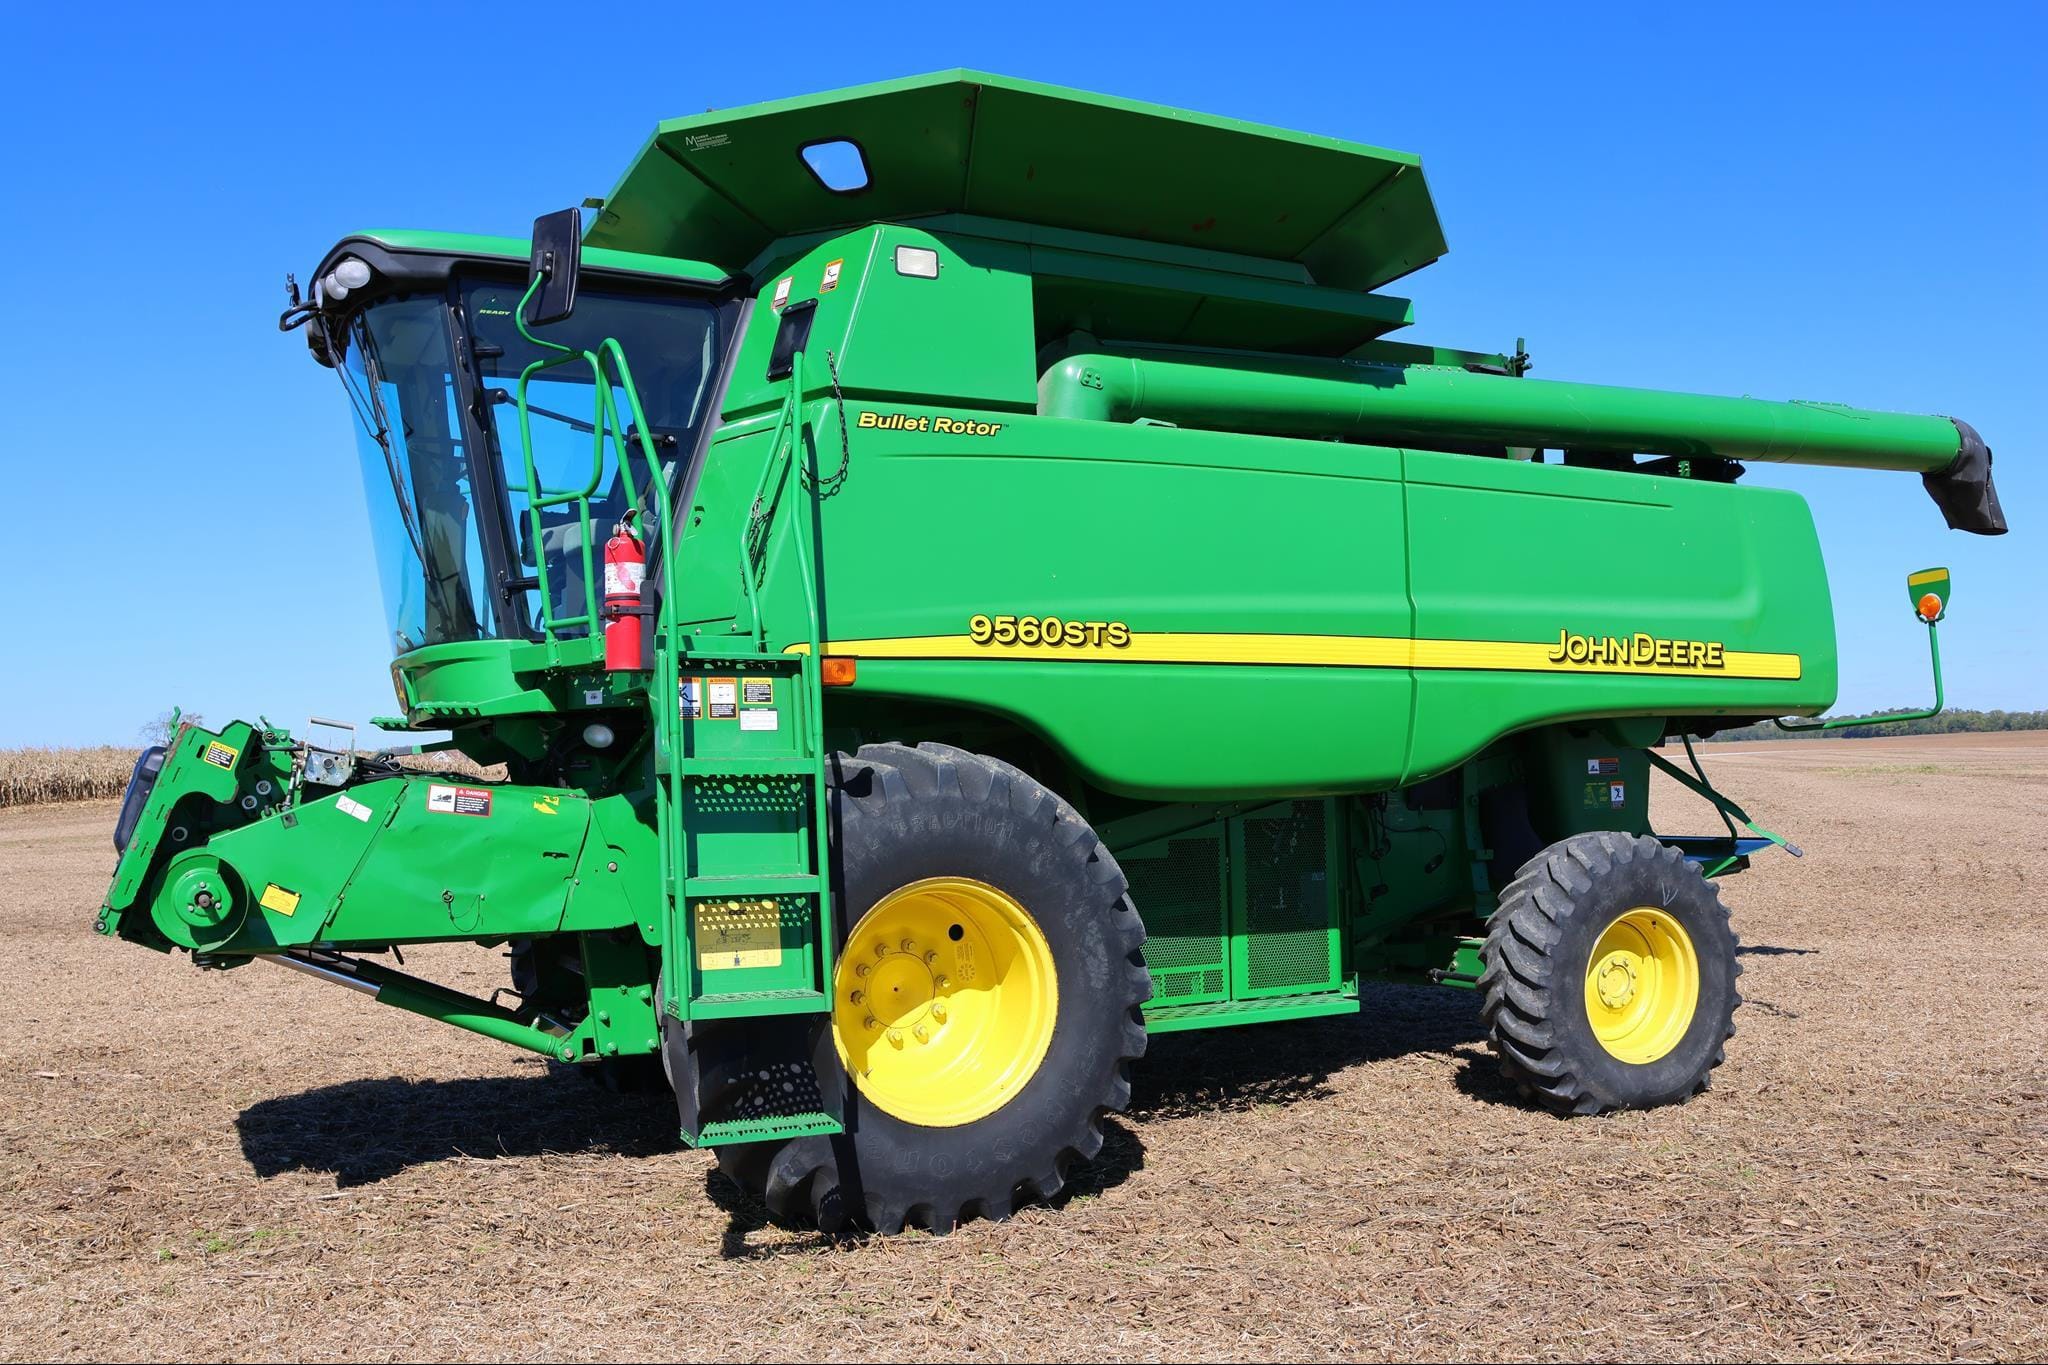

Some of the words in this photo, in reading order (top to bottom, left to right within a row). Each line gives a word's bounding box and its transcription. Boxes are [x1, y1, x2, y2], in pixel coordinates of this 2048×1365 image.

[857, 411, 930, 432] Bullet
[932, 416, 1002, 437] Rotor
[968, 614, 1131, 647] 9560STS
[1548, 628, 1630, 665] JOHN
[1632, 632, 1725, 669] DEERE
